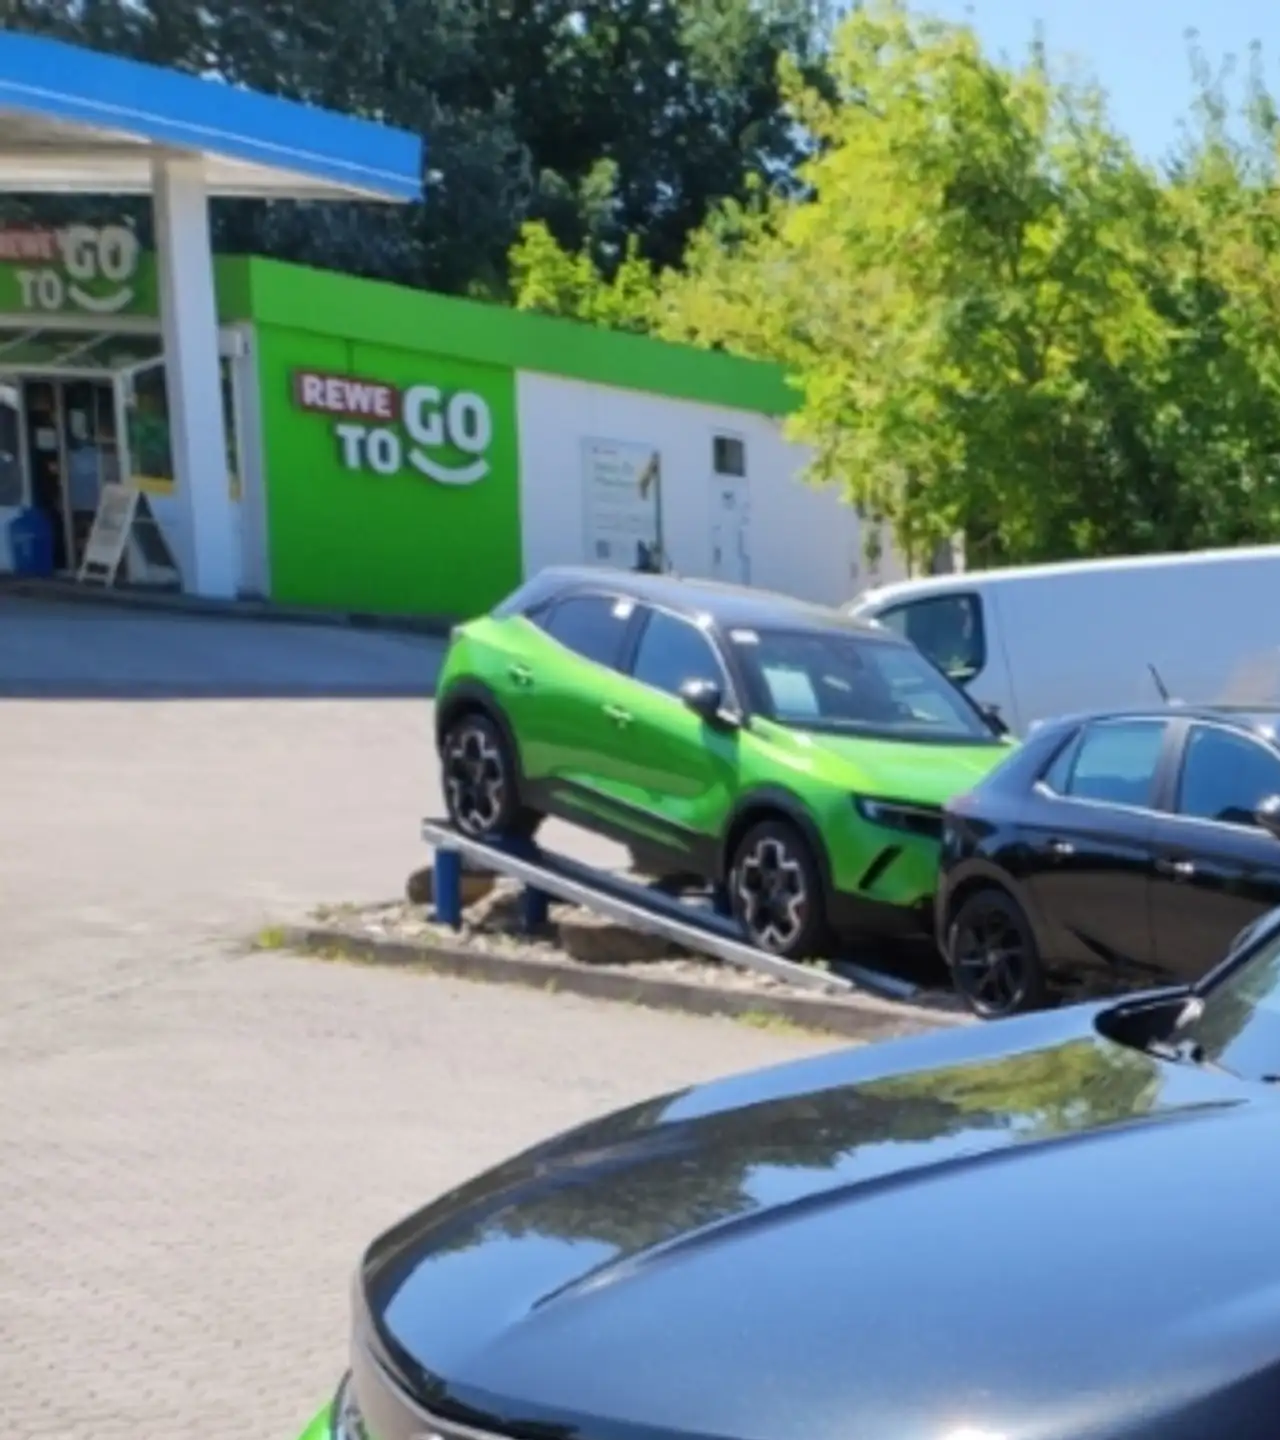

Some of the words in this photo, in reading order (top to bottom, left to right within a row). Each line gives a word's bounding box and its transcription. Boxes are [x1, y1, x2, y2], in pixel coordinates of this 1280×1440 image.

[57, 224, 139, 282] GO
[15, 268, 63, 309] TO
[302, 373, 392, 418] REWE
[403, 385, 492, 454] GO
[335, 423, 400, 475] TO
